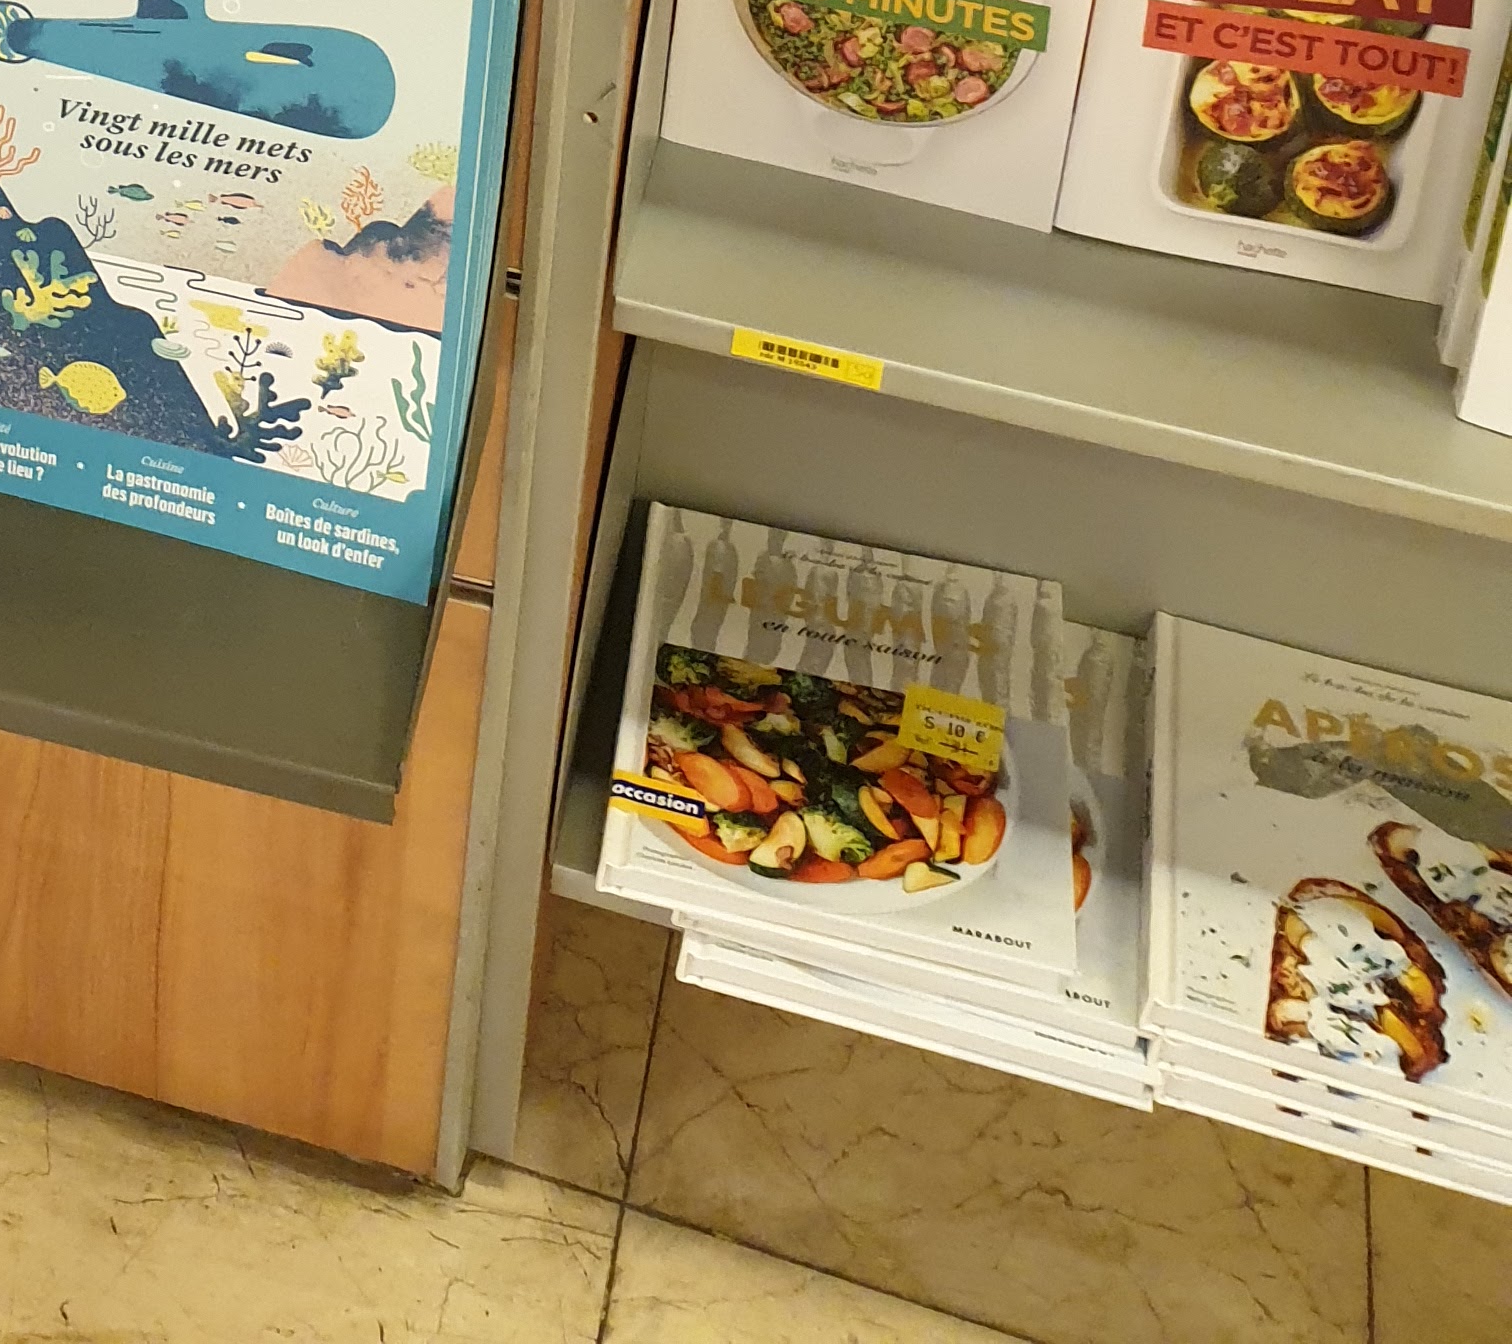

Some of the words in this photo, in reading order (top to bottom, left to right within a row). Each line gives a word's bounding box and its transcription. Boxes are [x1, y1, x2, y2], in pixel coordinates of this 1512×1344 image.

[1154, 13, 1204, 46] ET
[1212, 21, 1324, 69] C'EST
[1335, 38, 1462, 88] TOUT!
[58, 97, 142, 136] Vingt
[146, 118, 230, 150] mille
[235, 135, 313, 164] mets
[79, 132, 149, 161] sous
[155, 140, 197, 169] les
[203, 159, 283, 186] mers
[102, 482, 127, 506] des
[128, 488, 217, 526] profondeurs
[106, 462, 125, 483] La
[126, 469, 216, 505] gastronomie
[611, 779, 701, 817] occasion
[952, 922, 1033, 952] MARABOUT
